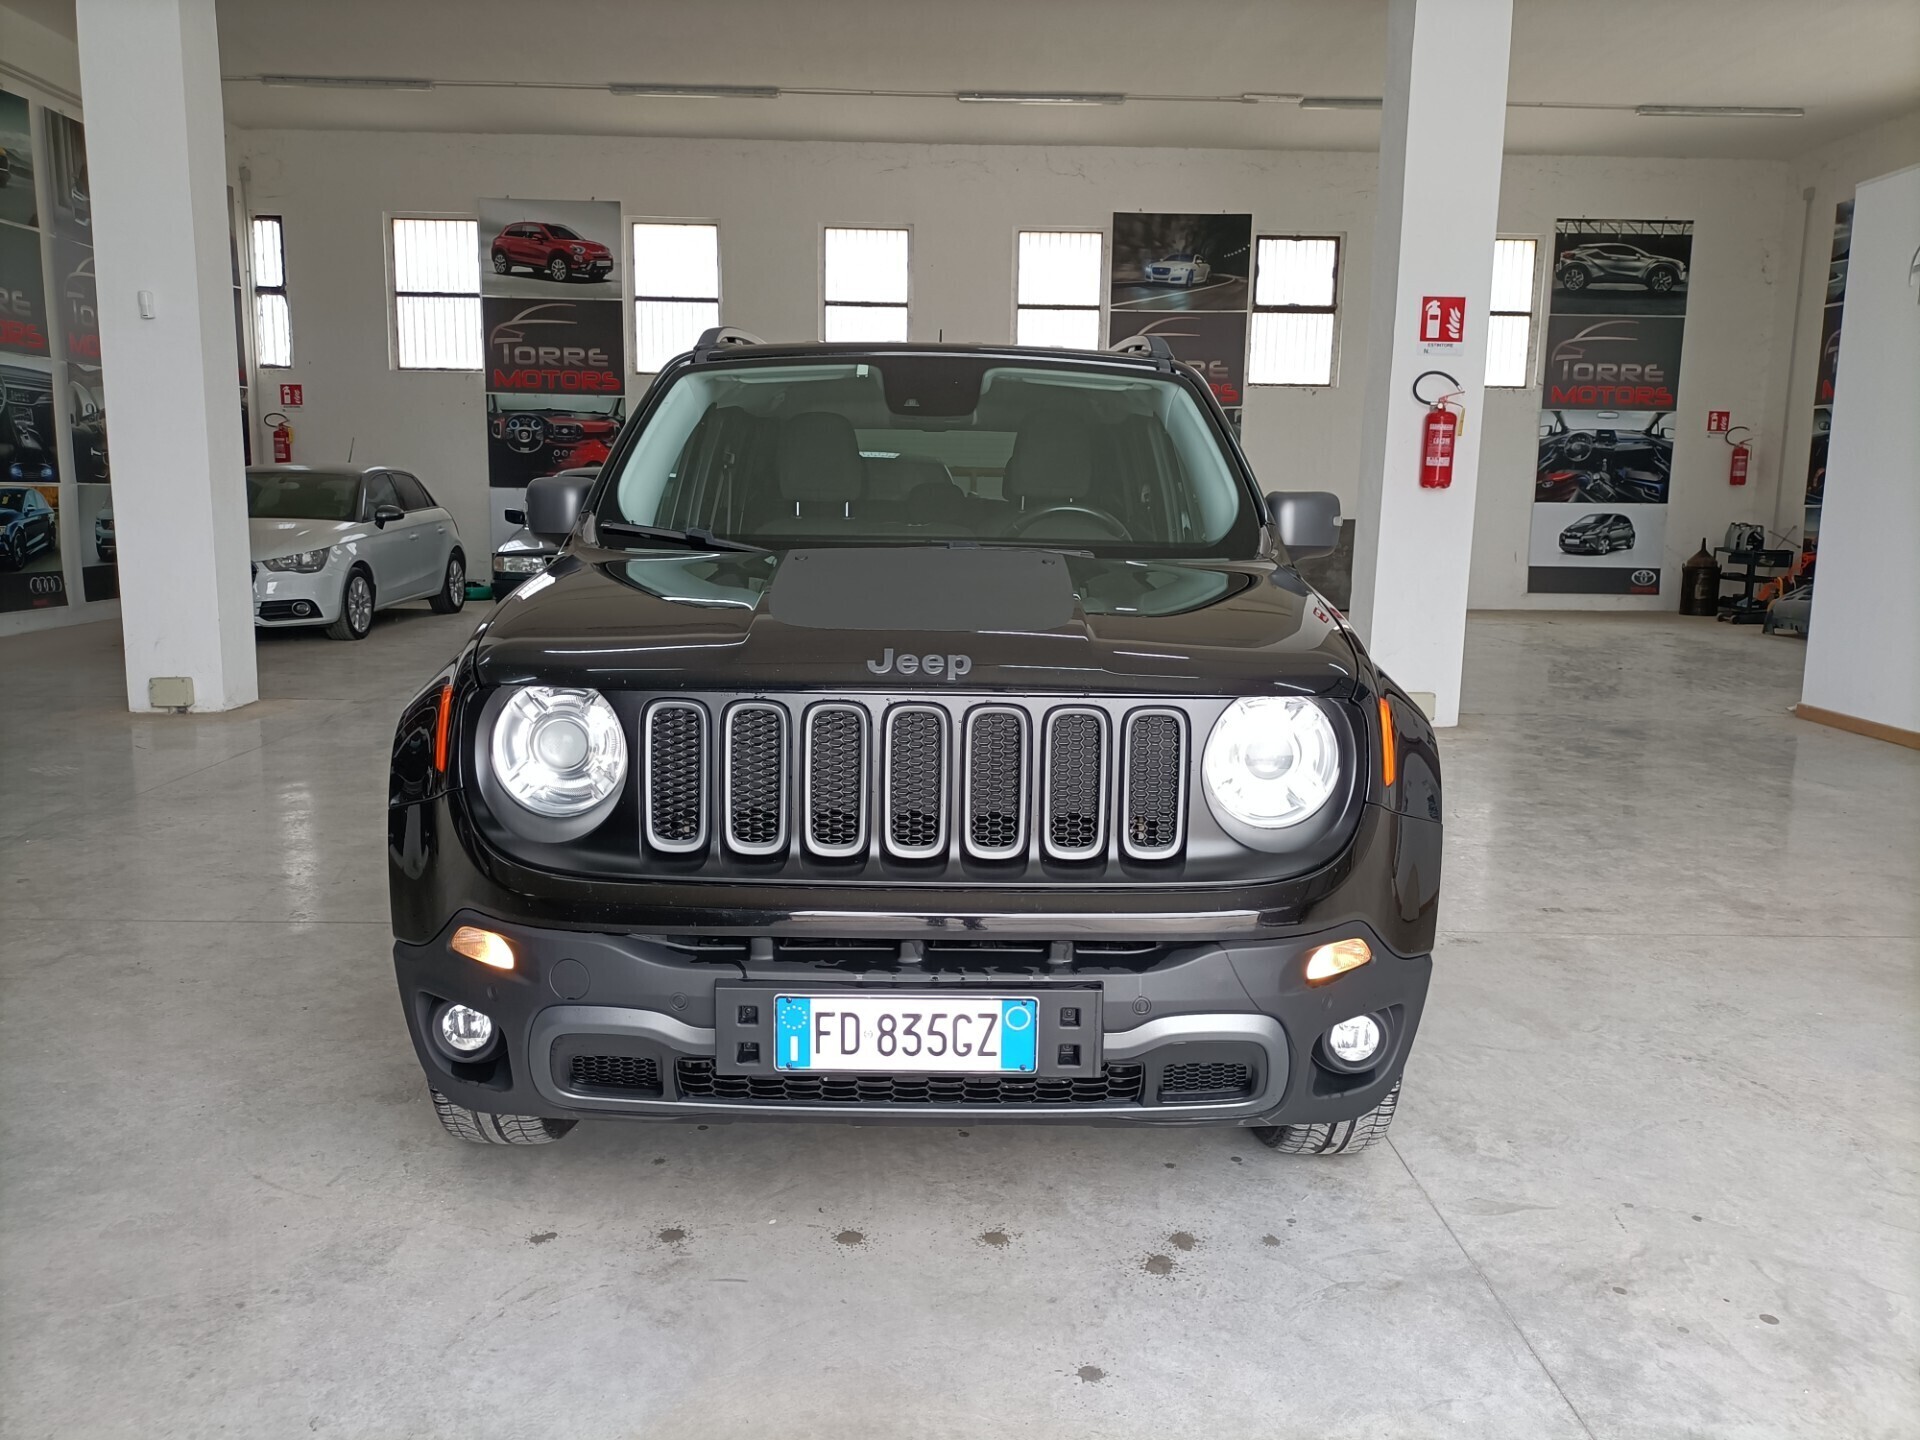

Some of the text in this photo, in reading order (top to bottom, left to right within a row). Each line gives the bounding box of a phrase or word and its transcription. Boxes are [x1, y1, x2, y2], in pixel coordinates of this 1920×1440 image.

[497, 339, 609, 367] TORRE
[494, 369, 621, 390] MOTORS
[1557, 355, 1665, 382] TORRE
[1551, 385, 1674, 406] MOTORS
[866, 648, 972, 680] Jeep
[815, 1012, 861, 1055] FD
[877, 1013, 998, 1057] 835GZ
